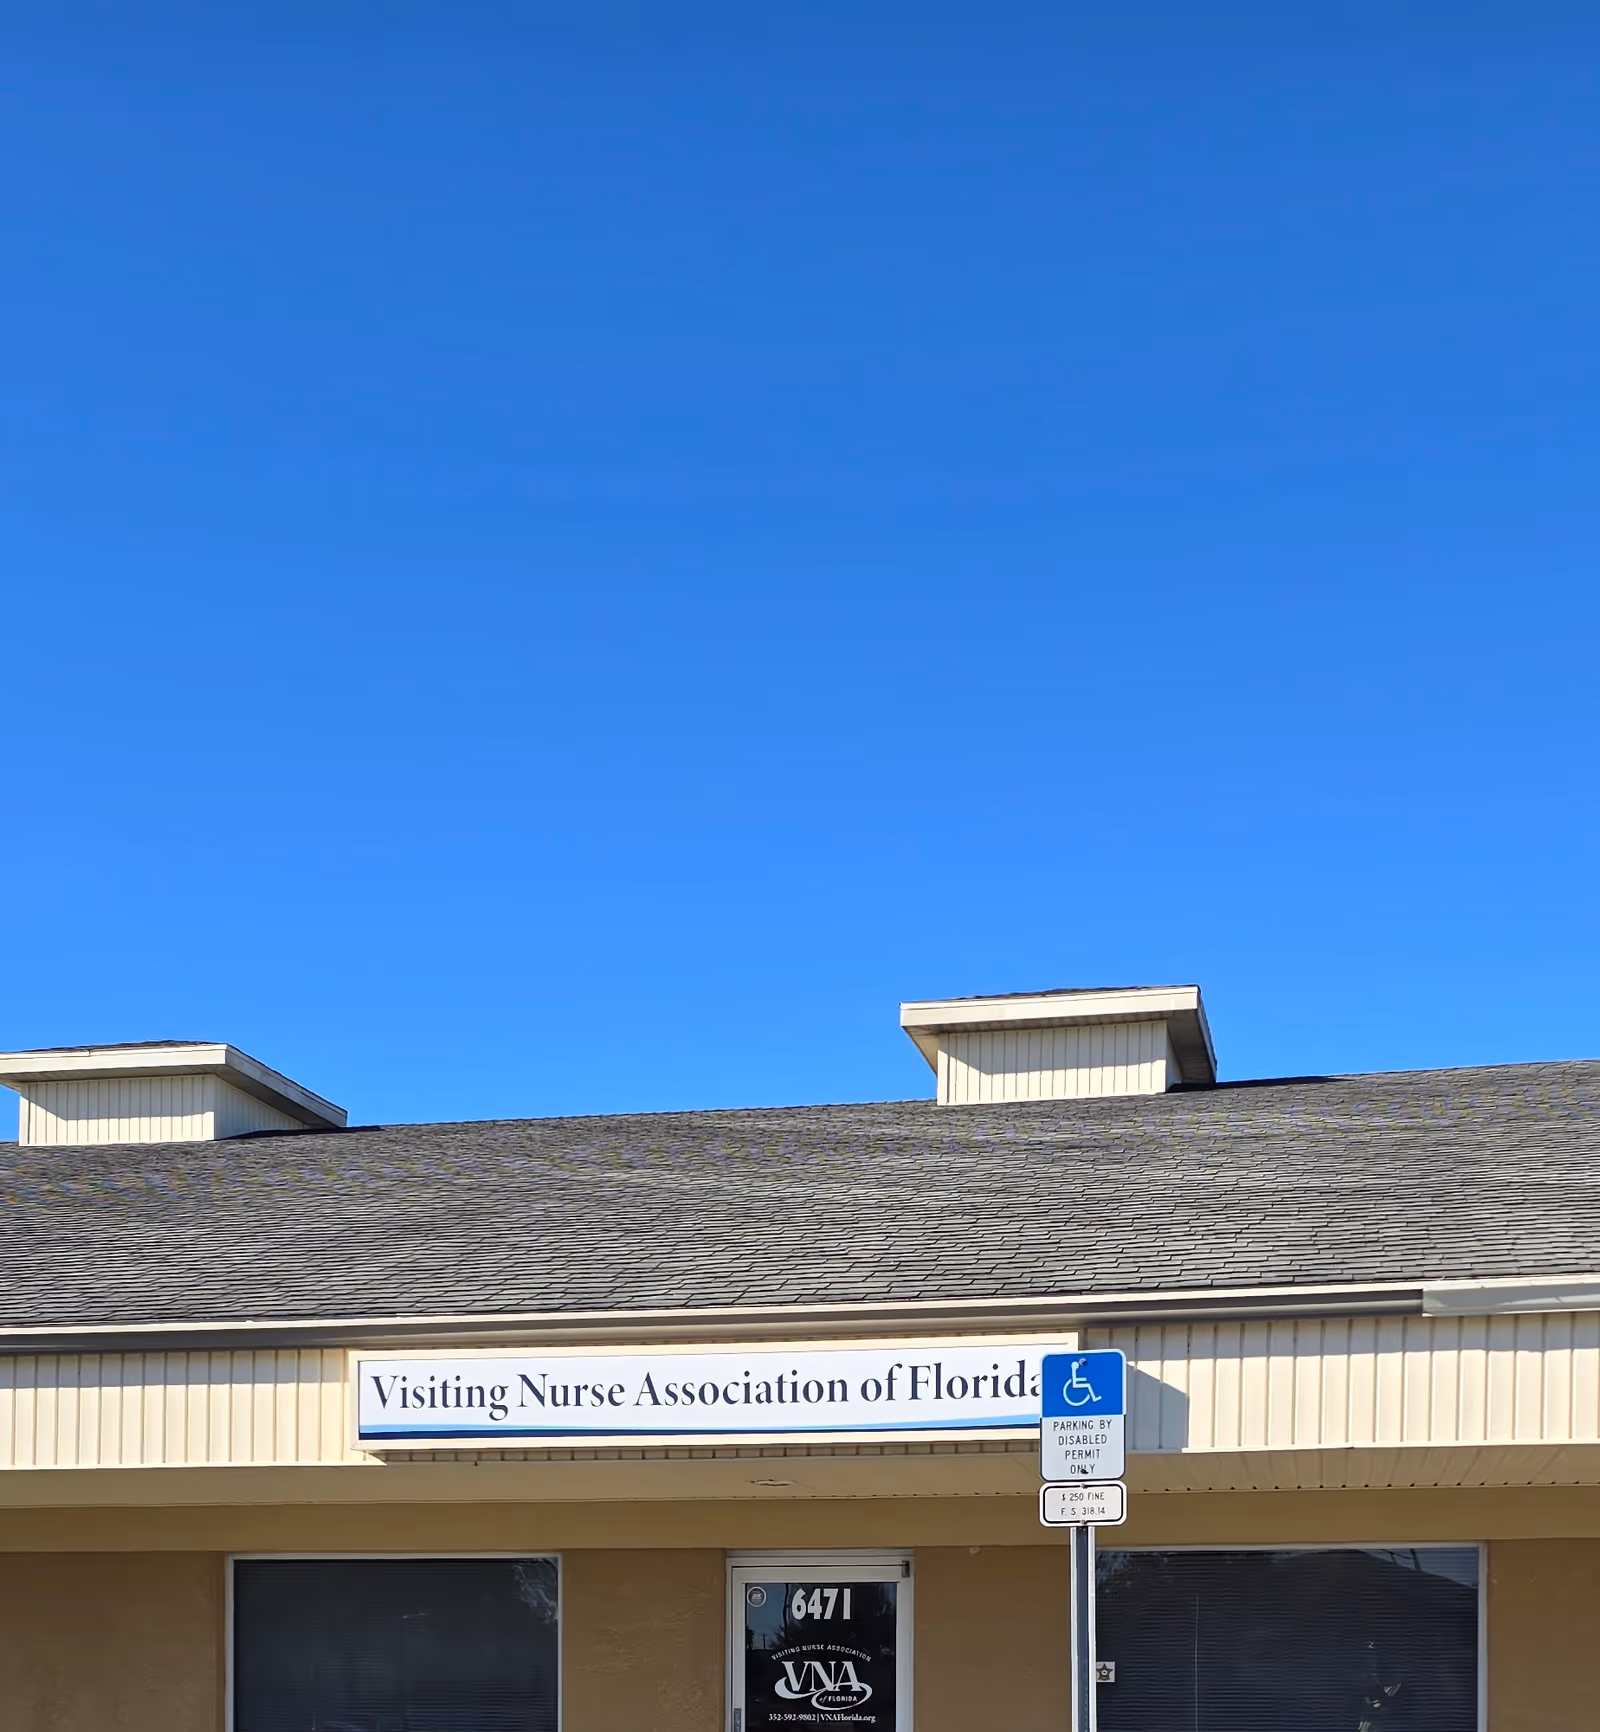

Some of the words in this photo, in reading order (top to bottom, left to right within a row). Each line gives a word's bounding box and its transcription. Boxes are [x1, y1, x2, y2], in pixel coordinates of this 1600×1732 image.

[370, 1373, 510, 1421] Visiting
[517, 1371, 626, 1410] Nurse
[635, 1367, 850, 1409] Association
[860, 1361, 899, 1403] of
[1053, 1420, 1094, 1431] PARKING
[1099, 1419, 1112, 1430] BY
[1058, 1434, 1107, 1446] DISABLED
[1065, 1448, 1101, 1460] PERMIT
[1069, 1493, 1084, 1502] 250
[1087, 1492, 1105, 1501] FINE
[791, 1588, 851, 1620] 6471
[771, 1646, 800, 1661] VISITING
[827, 1644, 872, 1662] ASSOCIATION
[781, 1661, 863, 1692] VNA
[819, 1695, 828, 1703] of
